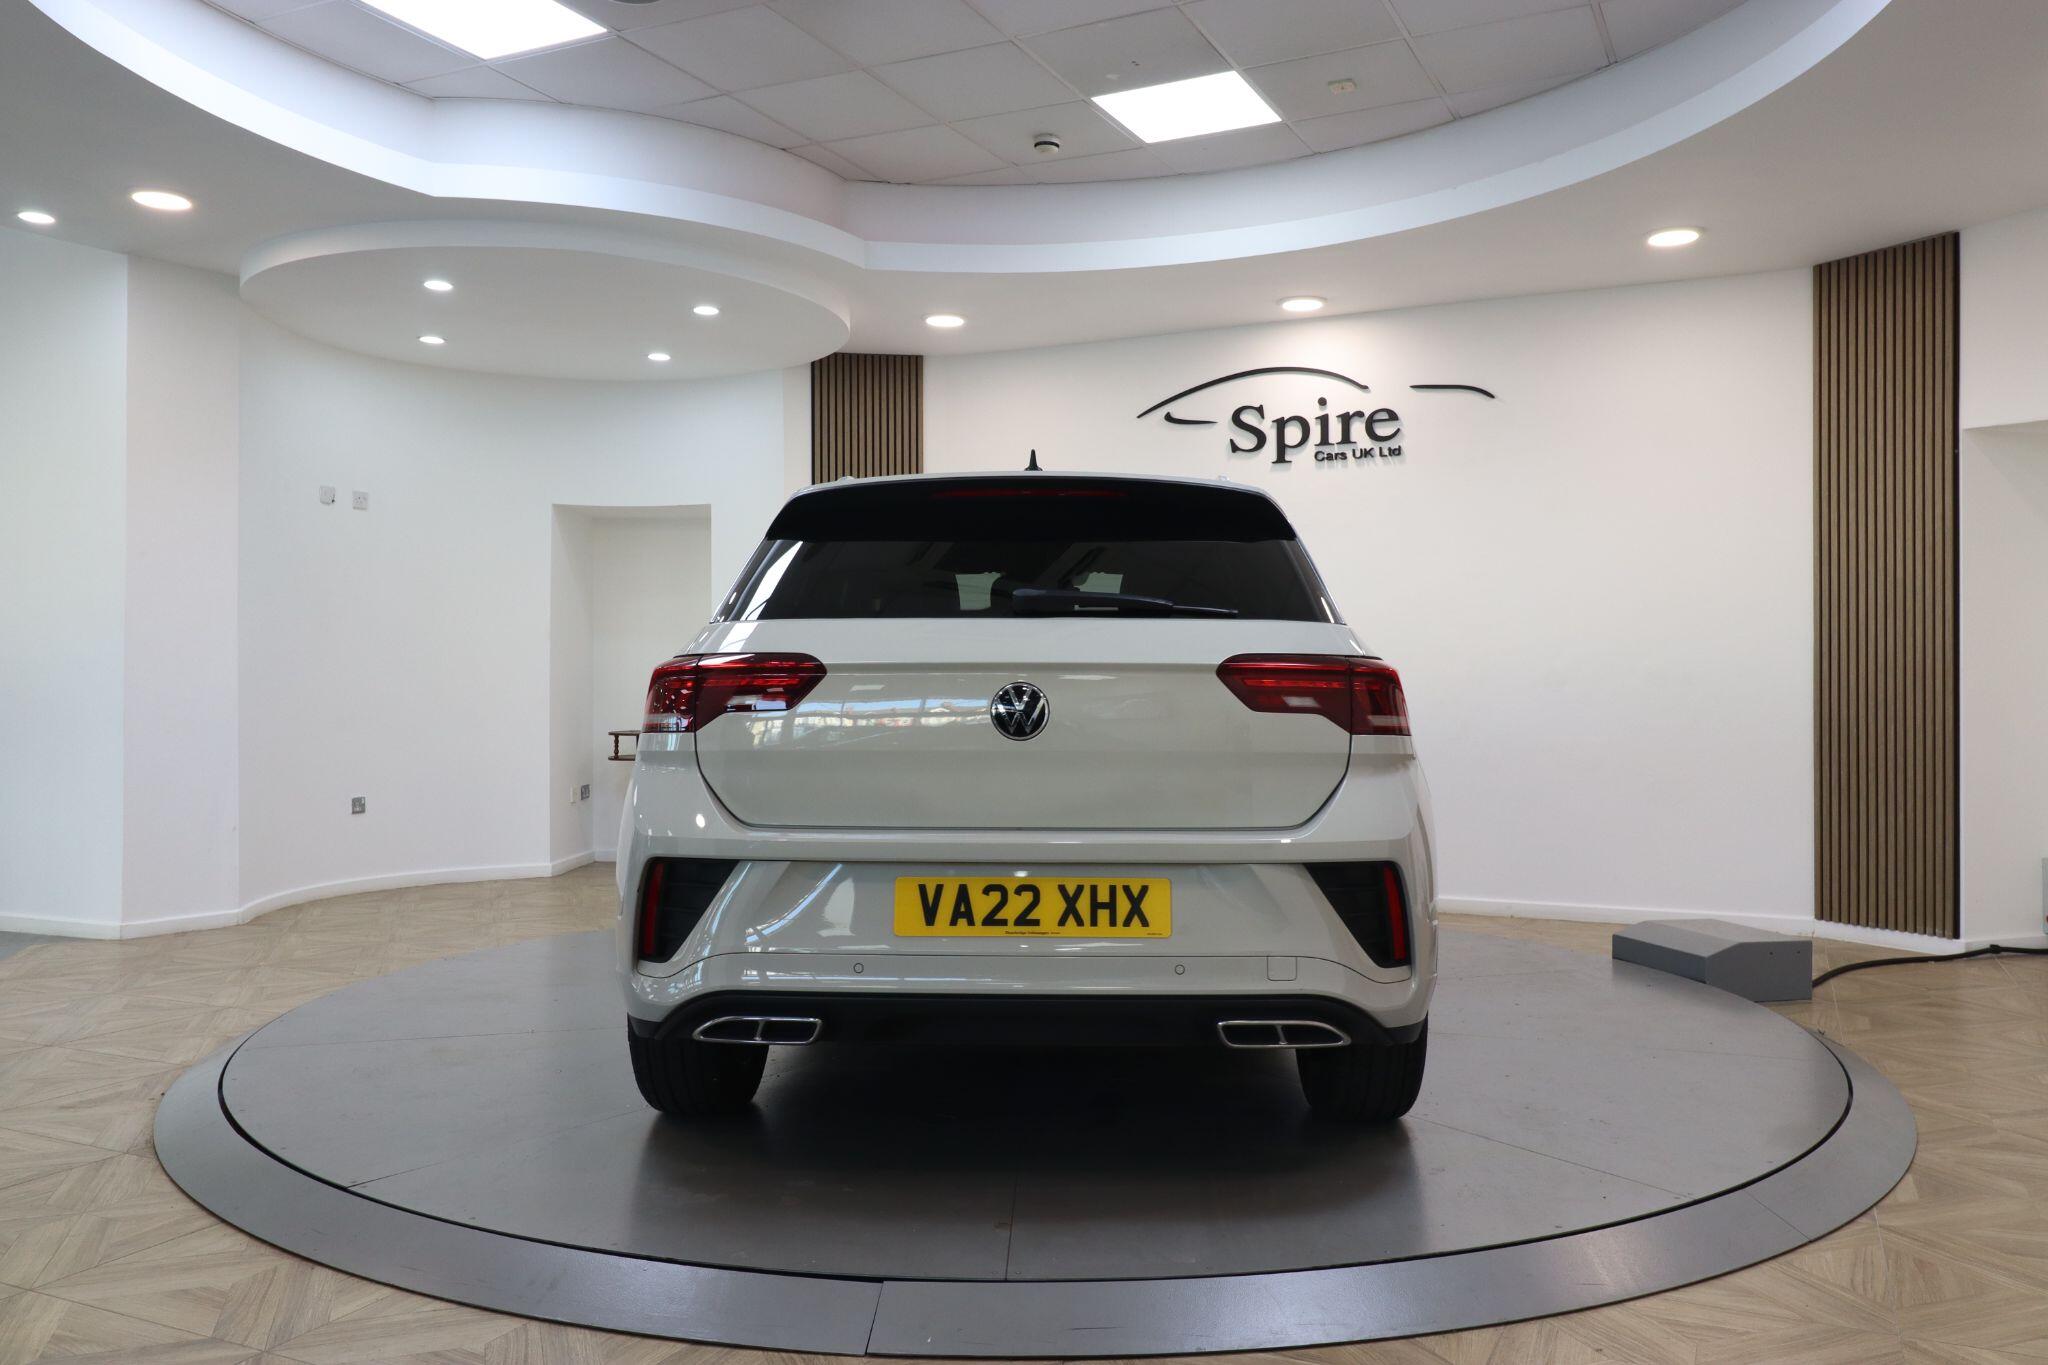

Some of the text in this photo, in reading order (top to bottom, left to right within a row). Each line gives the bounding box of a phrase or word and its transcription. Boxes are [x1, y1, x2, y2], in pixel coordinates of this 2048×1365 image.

[1229, 397, 1401, 464] Spire
[1314, 445, 1402, 462] Cars UK Ltd
[918, 883, 1150, 928] VA22 XHX
